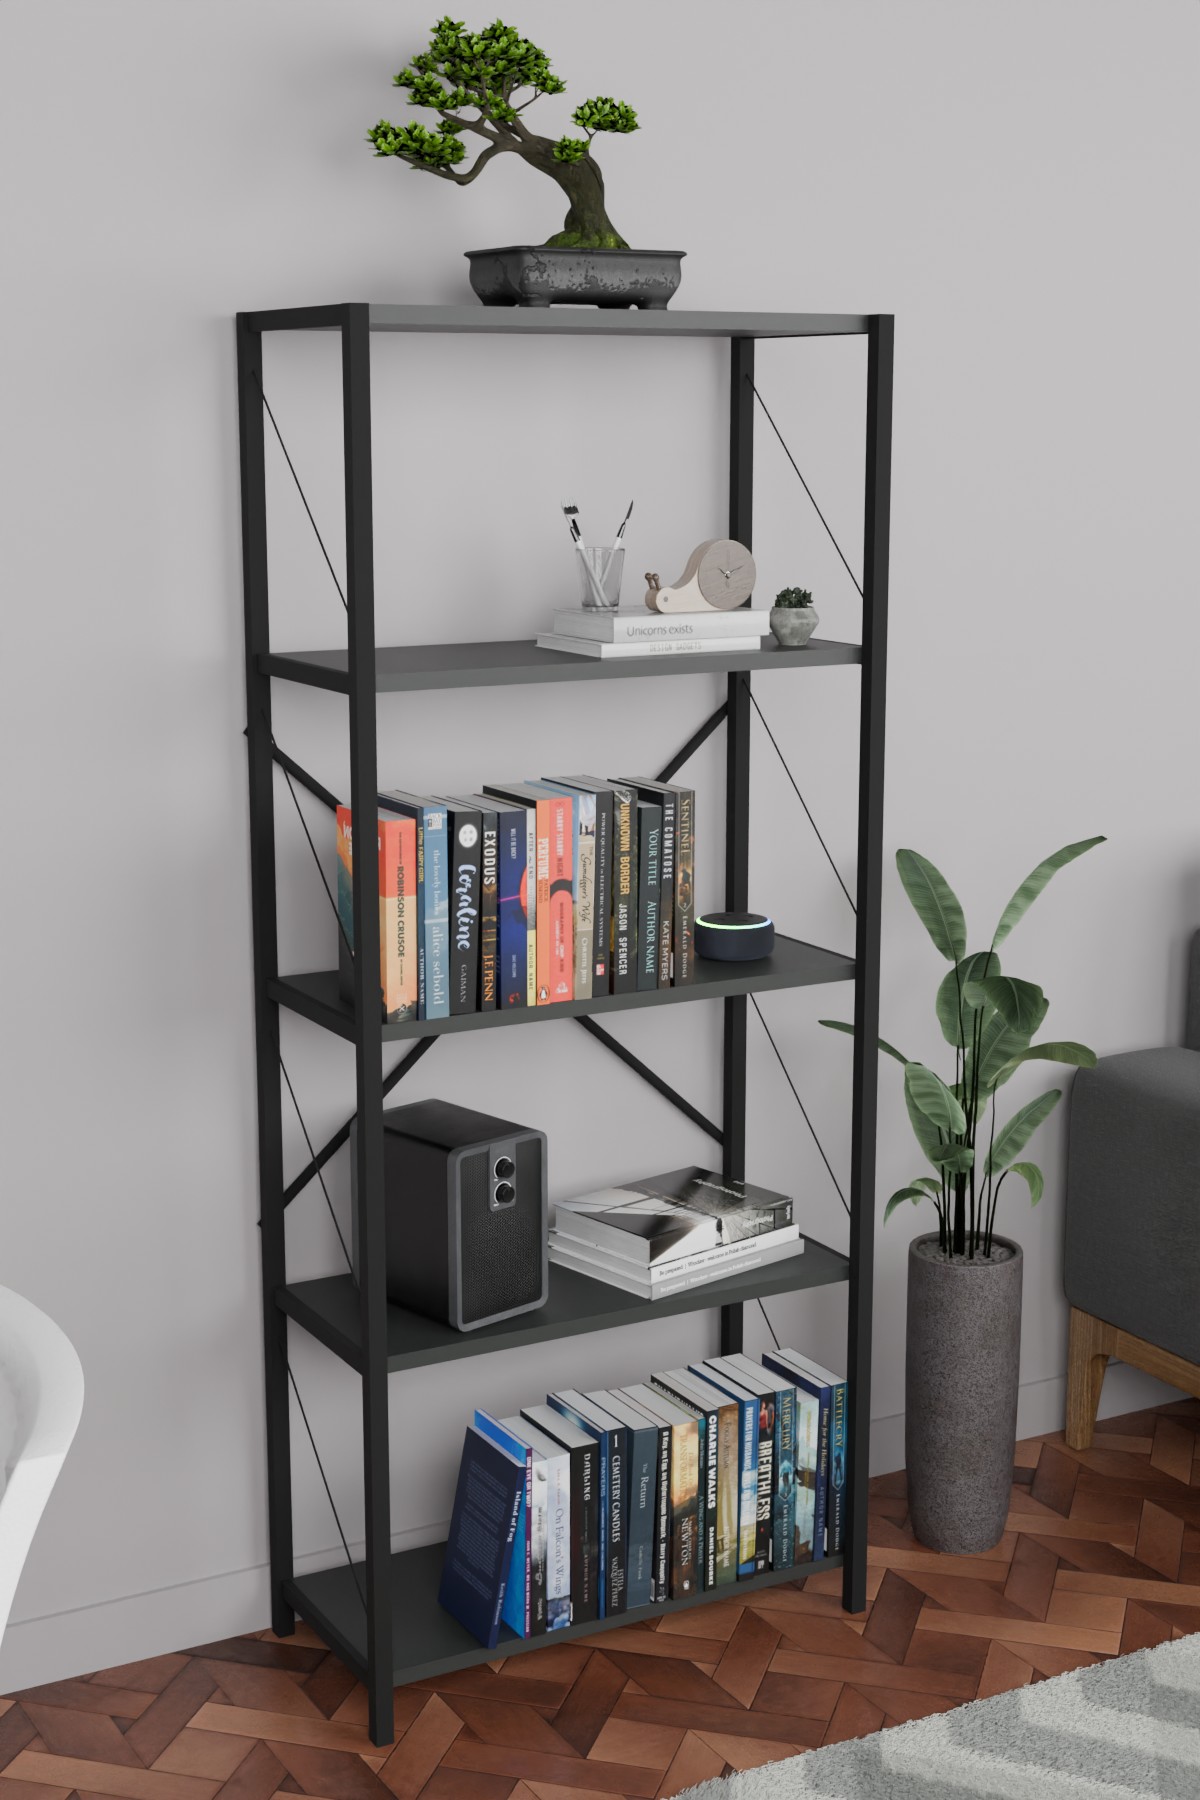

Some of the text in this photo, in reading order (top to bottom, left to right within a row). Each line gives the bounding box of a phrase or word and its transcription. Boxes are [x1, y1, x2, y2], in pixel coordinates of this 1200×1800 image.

[626, 624, 694, 637] Unicorns exists
[620, 804, 630, 895] UNKNOWN BORDER
[663, 803, 674, 879] THE COMATOSE
[680, 799, 690, 856] SENTINEL
[432, 865, 440, 888] lovely
[433, 850, 441, 864] the
[484, 830, 496, 886] EXODUS
[538, 838, 549, 880] PERFUME
[648, 828, 659, 886] YOUR TITLE
[397, 866, 405, 918] ROBINSON
[456, 864, 477, 951] Coraline
[580, 902, 591, 923] Wife
[618, 903, 628, 975] JASON SPENCER
[646, 901, 657, 974] AUTHOR NAME
[432, 926, 445, 1005] alice sebold
[460, 964, 468, 1003] GAIMAN
[484, 970, 494, 1002] PENN
[661, 948, 669, 981] MYERS
[614, 1434, 618, 1448] 1
[782, 1396, 791, 1451] MERCURY
[835, 1388, 844, 1448] BATTLECRY
[583, 1453, 591, 1501] DARLING
[708, 1415, 717, 1510] CHARLIE WALKS
[757, 1440, 773, 1521] BREATHLESS
[507, 1491, 522, 1543] Island of Fog
[555, 1508, 564, 1526] On
[611, 1455, 621, 1543] CEMETERY CANDLES
[639, 1476, 649, 1508] Return
[555, 1526, 565, 1563] Falcon's
[681, 1518, 689, 1566] NEWTON
[554, 1564, 564, 1595] Wings
